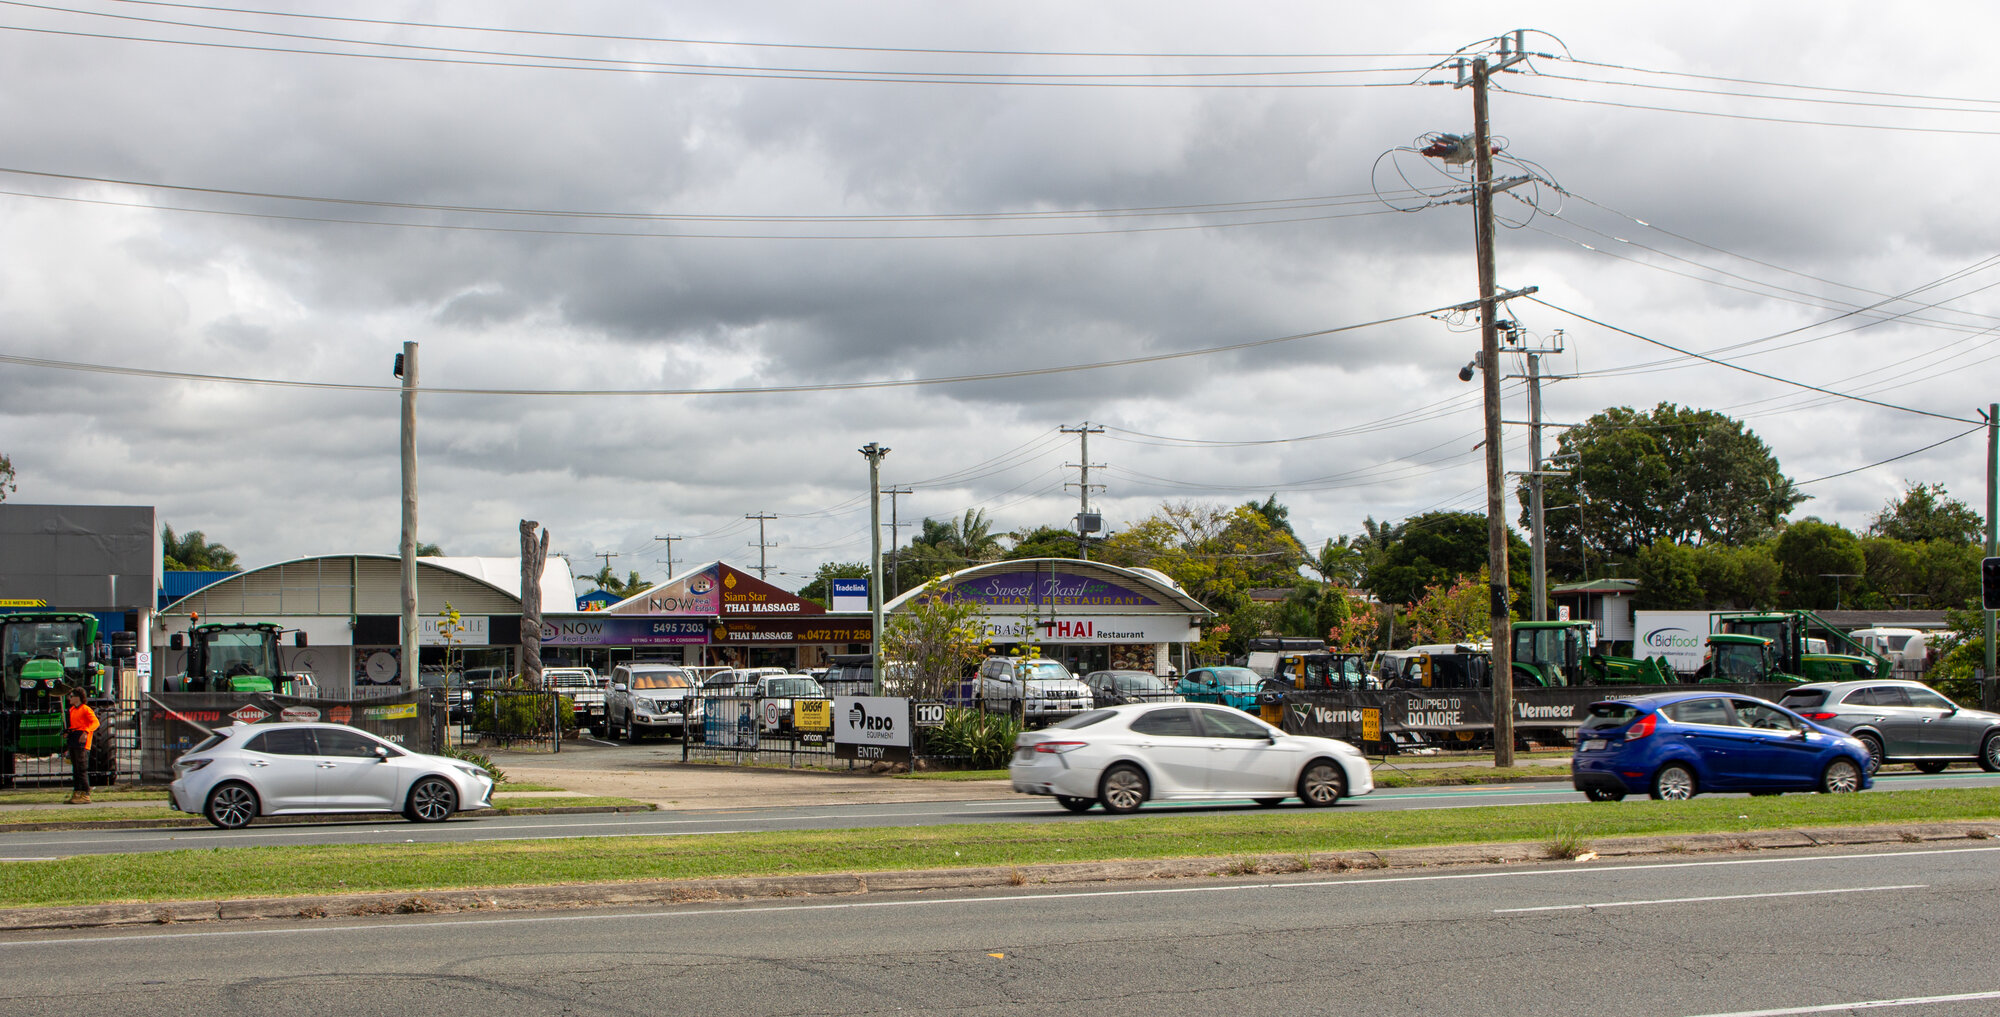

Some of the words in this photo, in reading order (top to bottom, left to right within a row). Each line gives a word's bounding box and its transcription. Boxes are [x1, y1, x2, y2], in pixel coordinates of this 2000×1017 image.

[835, 584, 865, 592] Tradelink
[985, 579, 1034, 597] Sweet
[1041, 580, 1089, 597] Basil
[724, 592, 746, 602] Siam
[749, 592, 767, 601] Star
[1043, 597, 1144, 605] RESTAURANT
[650, 597, 694, 611] NOW
[725, 604, 750, 612] THAI
[753, 603, 800, 612] MASSAGE
[563, 623, 603, 634] NOW
[653, 624, 677, 632] 5495
[680, 624, 704, 632] 7303
[994, 624, 1026, 636] BASI
[1045, 621, 1093, 637] THAI
[1097, 630, 1144, 639] Restaurant
[729, 632, 750, 640] THAI
[752, 632, 793, 640] MASSAGE
[807, 630, 831, 640] 0472
[833, 630, 850, 640] 771
[853, 630, 871, 640] 258
[1655, 635, 1698, 648] Bidfood
[802, 702, 822, 712] DIGGA
[1407, 698, 1447, 710] EQUIPPED
[1449, 698, 1461, 709] TO
[236, 710, 264, 719] KUHN
[767, 708, 776, 719] 10
[918, 705, 943, 721] 110
[1363, 710, 1378, 718] ROAD
[1518, 703, 1574, 718] Vermeer
[165, 711, 220, 721] MANITOU
[1408, 712, 1424, 726] DO
[867, 717, 893, 731] RDO
[803, 733, 822, 742] oricom
[867, 731, 894, 739] EQUIPMENT
[1363, 731, 1379, 739] AHEAD
[857, 747, 884, 759] ENTRY
